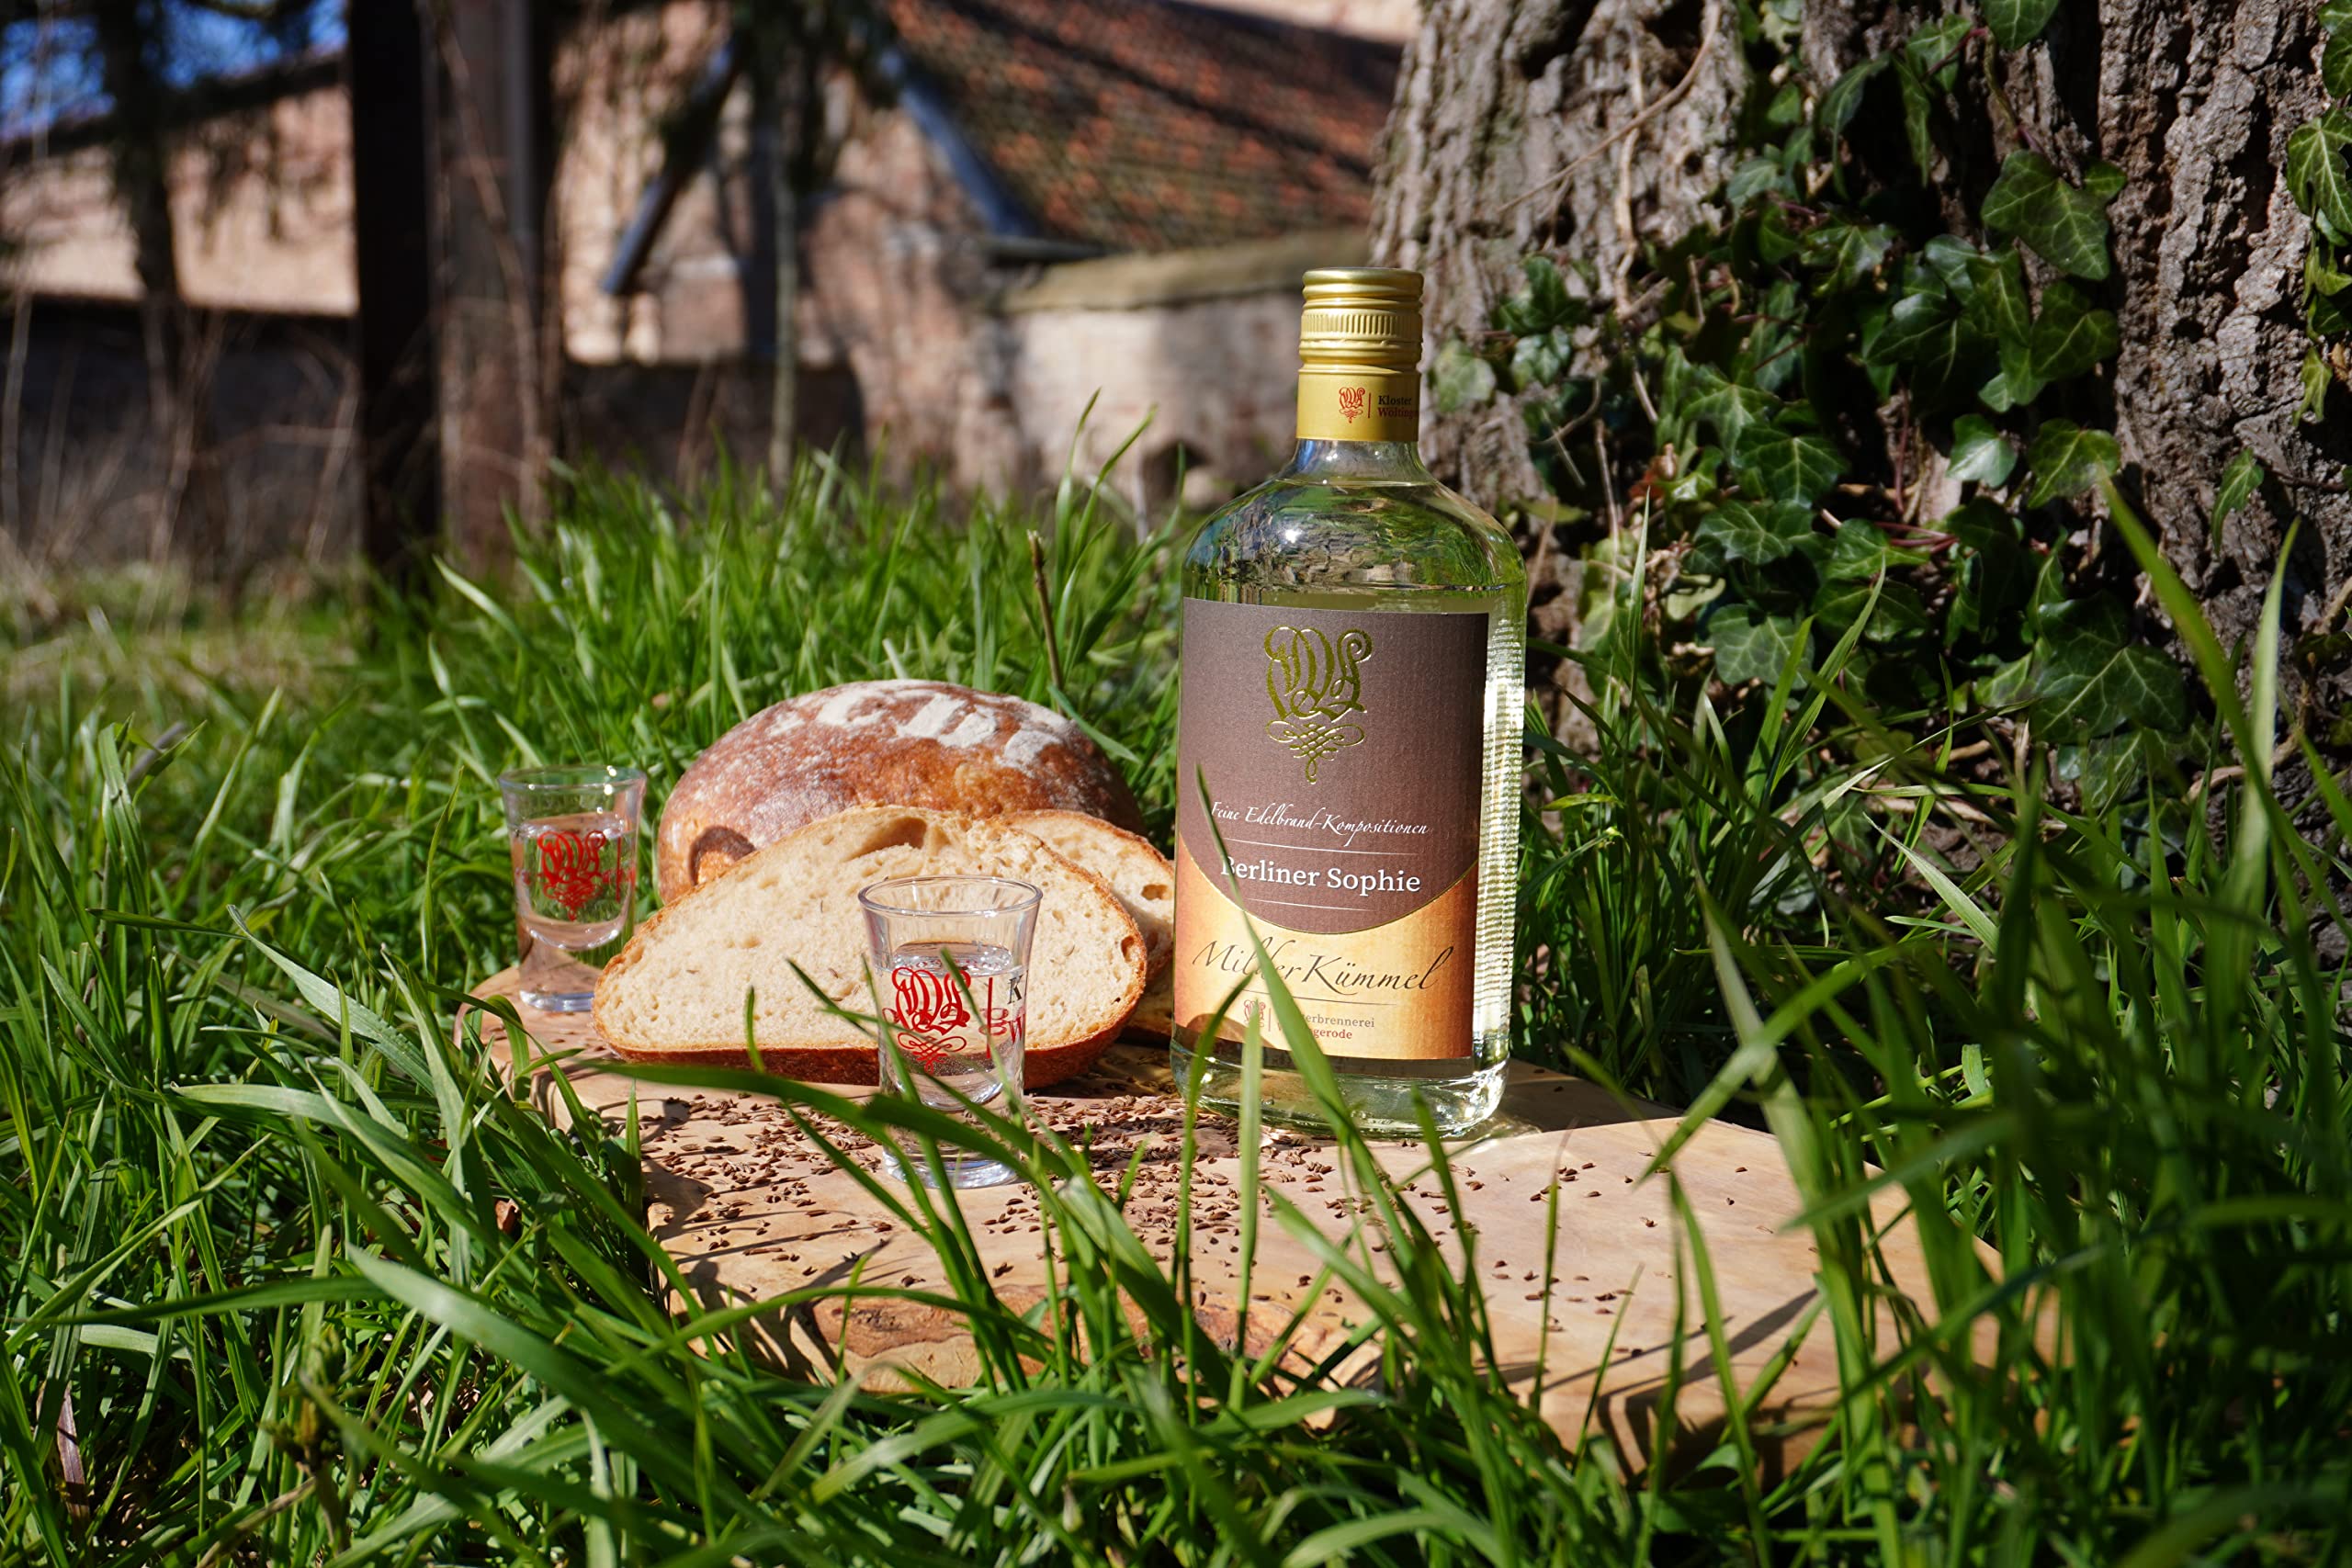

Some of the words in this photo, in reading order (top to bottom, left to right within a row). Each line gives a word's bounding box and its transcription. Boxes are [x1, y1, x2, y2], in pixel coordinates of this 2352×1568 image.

[1378, 395, 1412, 406] Kloster
[1211, 801, 1240, 821] Feine
[1245, 802, 1429, 847] Edelbrand-Kompositionen
[1327, 867, 1421, 897] Sophie
[1300, 946, 1454, 996] Kümmel
[1303, 1014, 1374, 1028] erbrennerei
